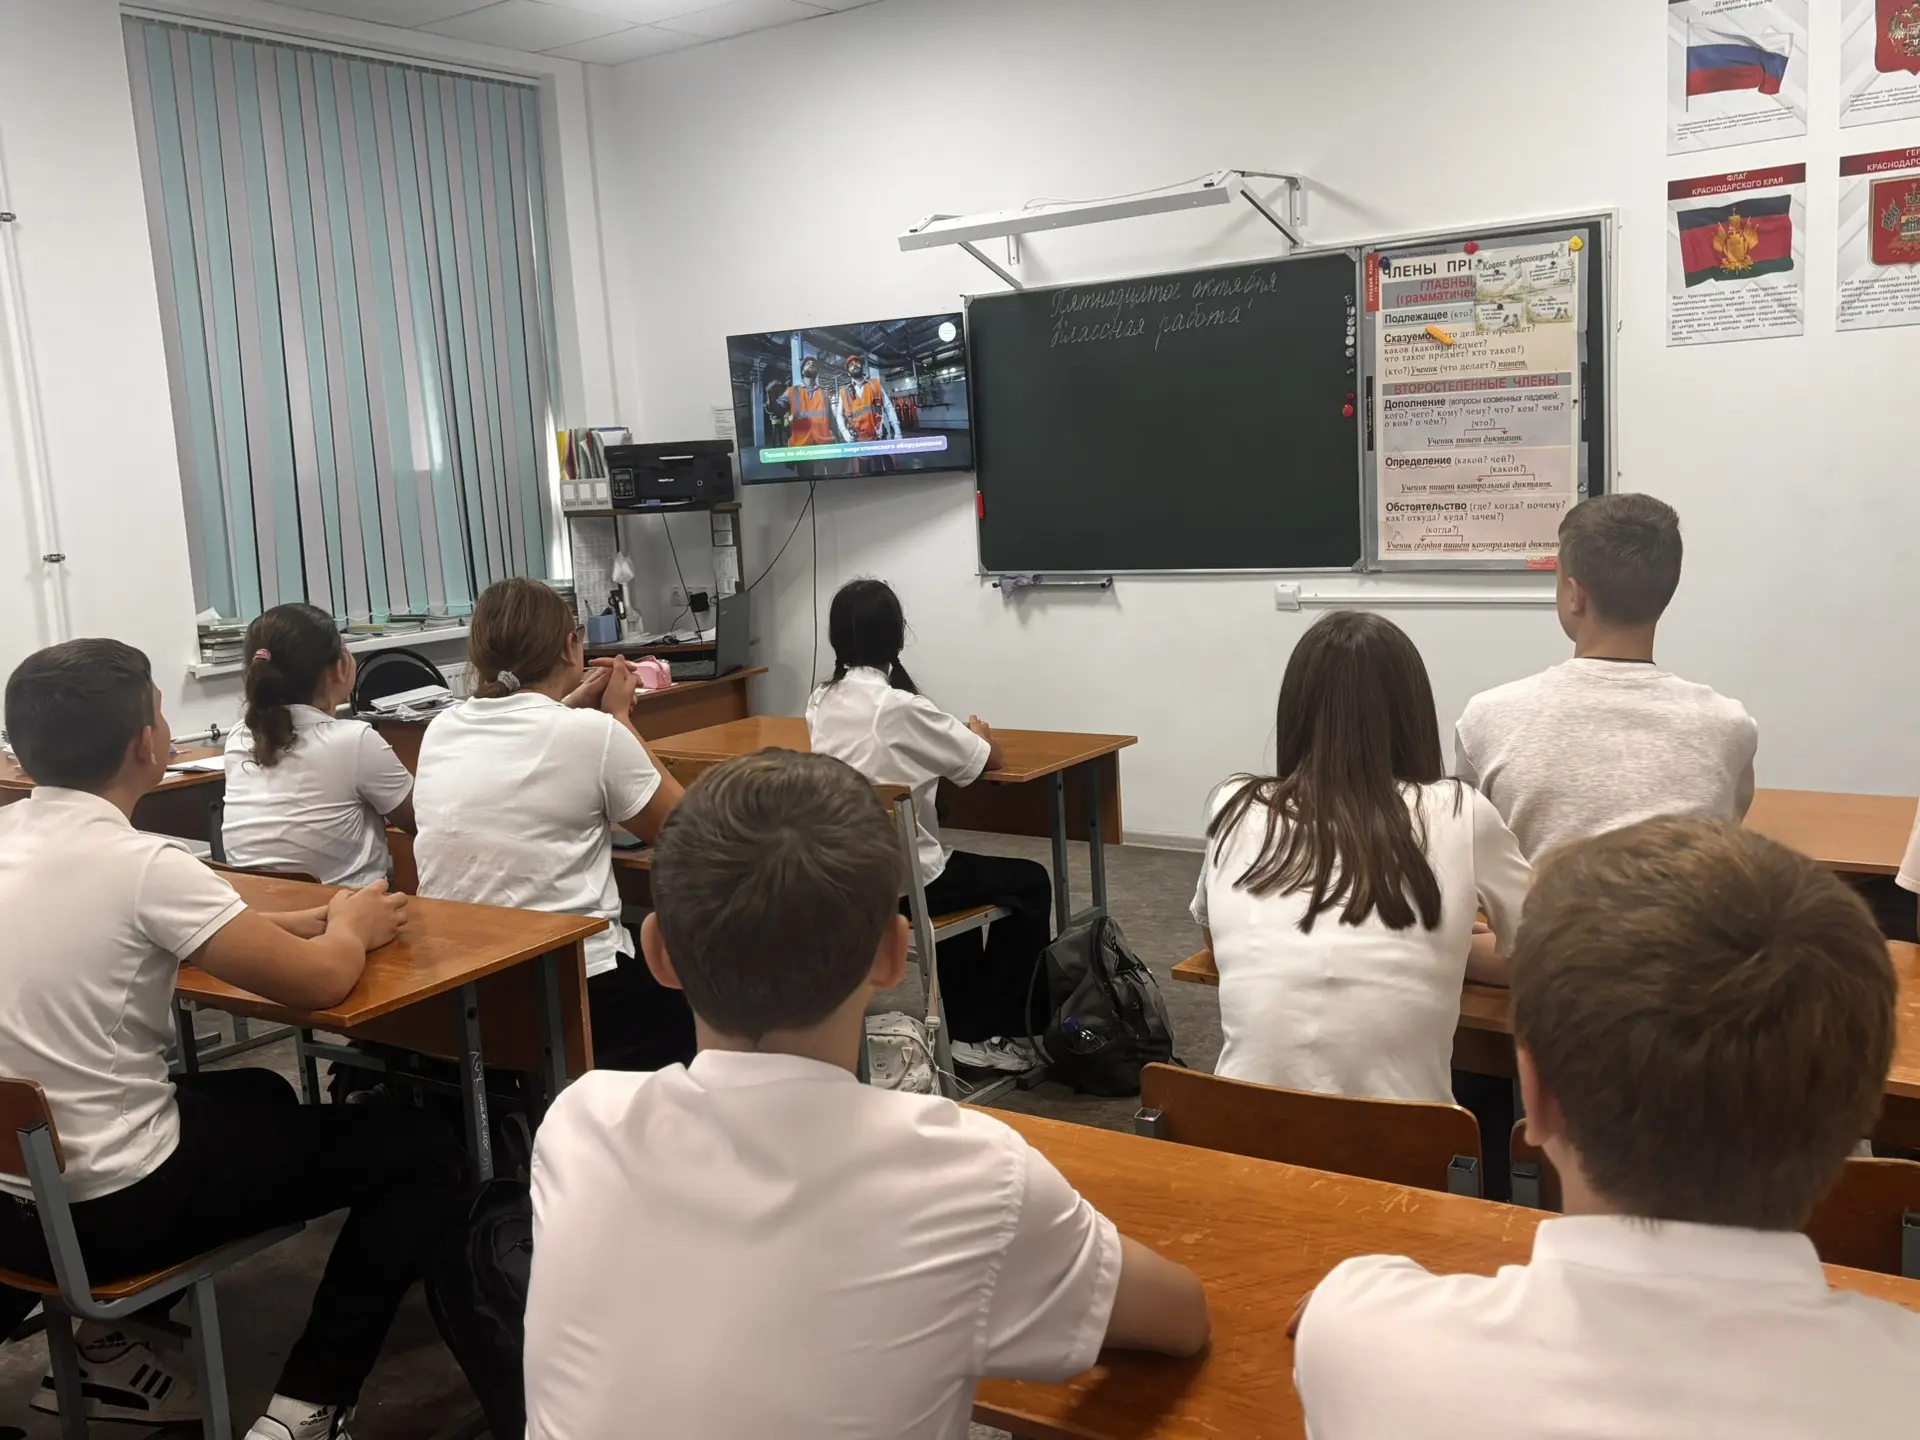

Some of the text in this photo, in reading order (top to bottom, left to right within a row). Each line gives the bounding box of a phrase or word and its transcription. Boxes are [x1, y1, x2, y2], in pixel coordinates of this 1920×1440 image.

[1726, 172, 1748, 182] ФЛАГ
[1691, 176, 1784, 196] КРАСНОДАРСКОГО КРАЯ
[1383, 262, 1437, 279] ЧЛЕНЫ
[1384, 310, 1448, 325] Подлежащее
[1155, 303, 1242, 351] работа
[1384, 347, 1409, 355] каков
[1384, 345, 1525, 363] что такое предмет? кто такой?)
[1410, 365, 1438, 375] Ученик
[1394, 375, 1559, 395] ВТОРОСТЕПЕННЫЕ ЧЛЕНЫ
[1384, 398, 1446, 411] Дополнение
[1483, 395, 1522, 404] косвенных
[1384, 402, 1564, 420] кого? чего? кому? чему? что? кем? чем?
[1392, 418, 1413, 427] ком?
[1471, 418, 1496, 428] (что?)
[1427, 437, 1454, 445] Ученик
[1385, 457, 1452, 468] Определение
[1454, 455, 1487, 466] (какой?
[1489, 464, 1527, 474] (какой?)
[1401, 483, 1428, 491] Ученик
[1456, 481, 1511, 491] контрольный
[1385, 500, 1566, 512] Обстоятельство (где? когда? почему?
[1385, 512, 1504, 524] как? откуда? куда? зачем?)
[1425, 526, 1459, 535] (когда?)
[1413, 540, 1442, 549] сегодня
[1471, 541, 1527, 550] контрольный
